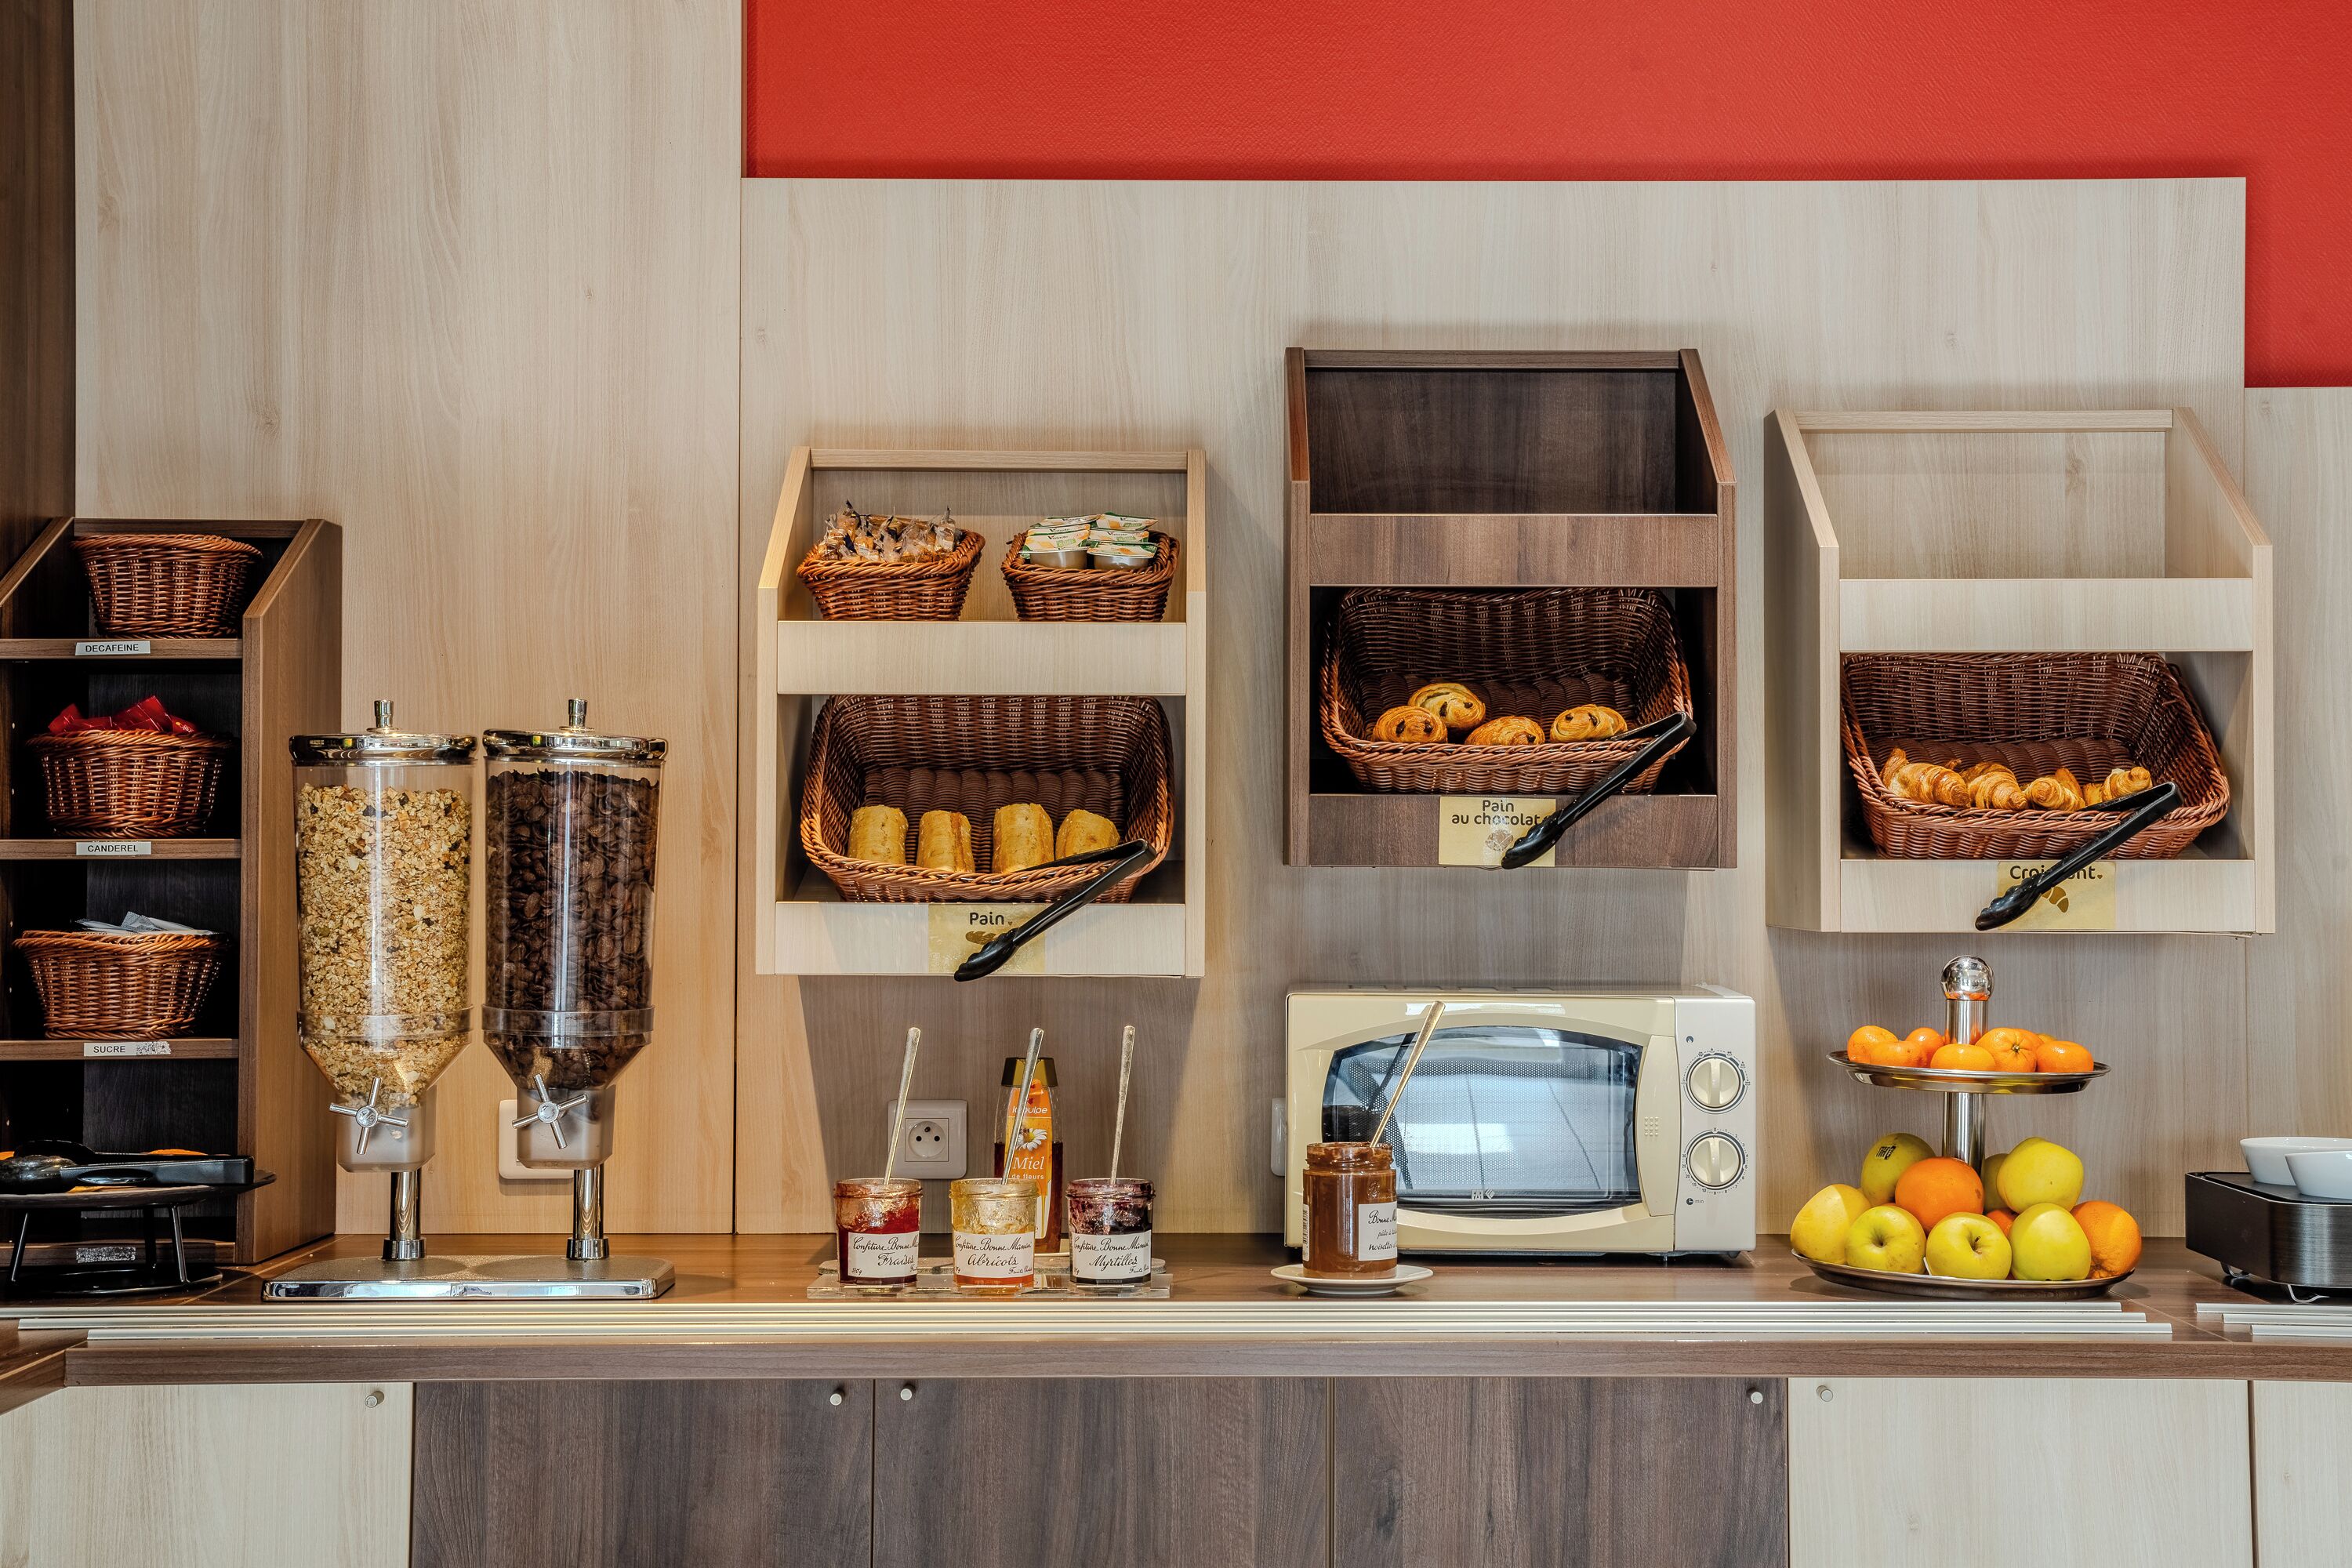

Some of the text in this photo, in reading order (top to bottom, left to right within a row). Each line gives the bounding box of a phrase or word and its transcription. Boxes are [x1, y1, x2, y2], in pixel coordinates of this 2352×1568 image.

[85, 644, 139, 652] DECAFEINE
[1483, 800, 1515, 812] Pain
[1452, 813, 1541, 826] au chocolat
[2009, 865, 2096, 880] Croint
[969, 912, 1004, 925] Pain
[93, 1045, 125, 1054] SUCRE
[1012, 1156, 1045, 1170] Miel
[1368, 1210, 1390, 1224] Bonne
[853, 1236, 886, 1253] Confiture
[887, 1236, 909, 1250] Bonne
[955, 1235, 978, 1251] Confiture
[980, 1237, 1007, 1250] Bonne
[1074, 1236, 1098, 1253] Confiture
[1099, 1237, 1127, 1251] Bonne
[877, 1252, 915, 1266] Fraises
[967, 1254, 1018, 1266] Abricots
[1089, 1253, 1138, 1272] Myrtilles
